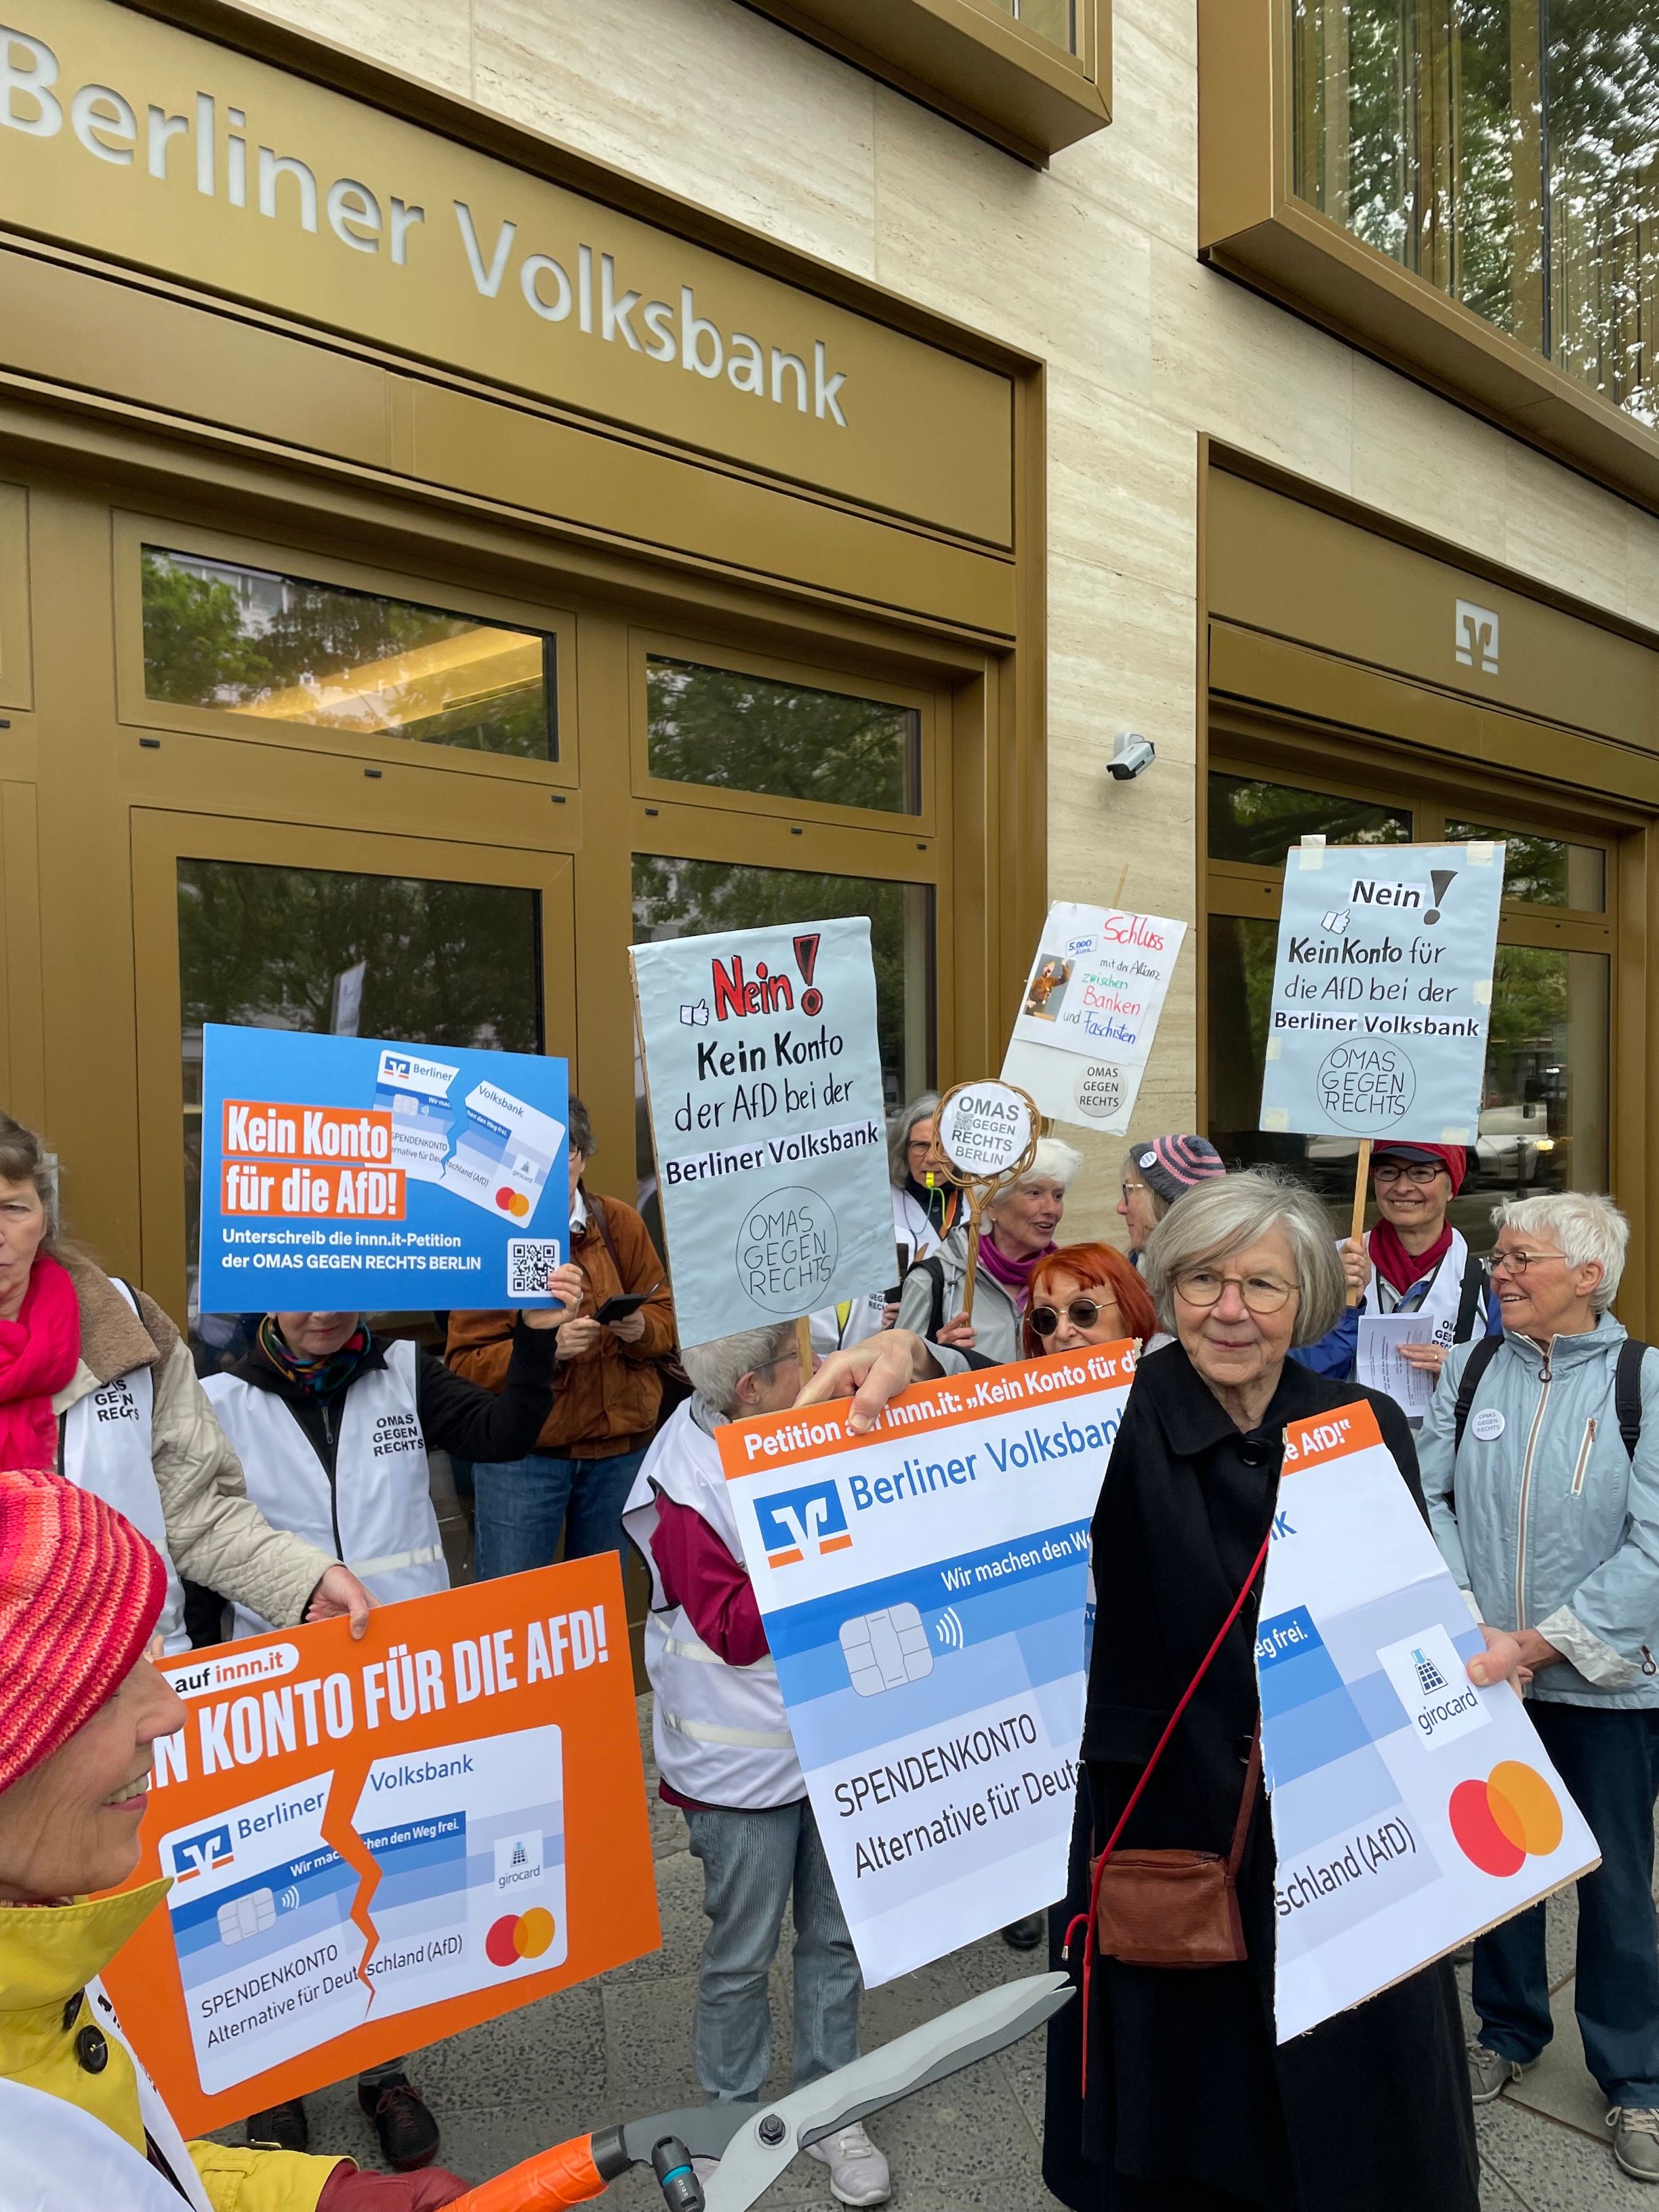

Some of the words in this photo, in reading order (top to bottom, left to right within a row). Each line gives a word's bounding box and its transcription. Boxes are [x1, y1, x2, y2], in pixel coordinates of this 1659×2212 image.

[0, 24, 425, 265] Berliner
[453, 200, 848, 428] Volksbank
[1069, 939, 1092, 951] 5.000
[1103, 916, 1164, 951] Schluss
[1409, 936, 1447, 964] für
[1082, 972, 1128, 989] zwischen
[1100, 958, 1115, 968] mit
[1116, 961, 1129, 972] der
[1130, 960, 1160, 981] Allianz
[1083, 985, 1141, 1015] Banken
[1285, 975, 1317, 999] die
[1322, 976, 1364, 1000] AfD
[1369, 977, 1408, 1001] bei
[1418, 978, 1458, 1002] der
[1063, 1011, 1080, 1024] und
[1084, 1010, 1136, 1044] Faschisten
[1274, 1012, 1357, 1031] Berliner
[1364, 1015, 1480, 1036] Volksbank
[697, 1040, 766, 1081] Kein
[774, 1025, 843, 1067] Konto
[1330, 1048, 1395, 1071] OMAS
[413, 1064, 453, 1082] Berliner
[1087, 1067, 1118, 1078] OMAS
[1322, 1071, 1404, 1093] GEGEN
[1080, 1095, 1119, 1107] RECHTS
[1083, 1082, 1118, 1092] GEGEN
[479, 1085, 525, 1118] Volksbank
[675, 1092, 726, 1131] der
[733, 1082, 777, 1122] AfD
[785, 1078, 816, 1113] bei
[823, 1073, 854, 1106] der
[959, 1096, 1019, 1121] OMAS
[1324, 1091, 1406, 1115] RECHTS
[227, 1105, 295, 1153] Kein
[304, 1111, 388, 1160] Konto
[477, 1115, 487, 1125] den
[487, 1120, 498, 1131] Weg
[972, 1119, 1016, 1135] GEGEN
[391, 1132, 448, 1151] SPENDENKONTO
[666, 1147, 763, 1185] Berliner
[769, 1121, 879, 1163] Volksbank
[951, 1129, 1012, 1151] RECHTS
[418, 1151, 428, 1160] für
[955, 1145, 1004, 1165] BERLIN
[226, 1165, 273, 1212] für
[281, 1168, 329, 1213] die
[337, 1171, 397, 1215] AfD!
[472, 1172, 489, 1187] (AfD)
[750, 1206, 813, 1241] OMAS
[223, 1229, 325, 1246] Unterschreib
[329, 1231, 352, 1246] die
[356, 1232, 461, 1248] innn.it-Petition
[744, 1230, 826, 1269] GEGEN
[222, 1254, 249, 1268] der
[253, 1254, 304, 1269] OMAS
[307, 1255, 363, 1269] GEGEN
[365, 1256, 426, 1269] RECHTS
[429, 1257, 481, 1270] BERLIN
[749, 1255, 832, 1295] RECHTS
[376, 1414, 414, 1429] OMAS
[743, 1420, 841, 1460] Petition
[884, 1391, 963, 1429] innn.it:
[966, 1376, 1024, 1410] „Kein
[1026, 1364, 1086, 1397] Konto
[1088, 1356, 1117, 1380] für
[373, 1426, 418, 1443] GEGEN
[373, 1438, 424, 1457] RECHTS
[848, 1453, 977, 1511] Berliner
[985, 1408, 1124, 1473] Volksban
[941, 1565, 972, 1591] Wir
[976, 1549, 1042, 1585] machen
[1042, 1534, 1070, 1563] den
[1272, 1620, 1308, 1649] frei.
[175, 1669, 211, 1694] auf
[216, 1651, 284, 1682] innn.it
[199, 1672, 354, 1776] KONTO
[362, 1641, 443, 1730] FÜR
[452, 1630, 518, 1704] DIE
[527, 1605, 609, 1684] AFD!
[1417, 1686, 1479, 1736] girocard
[370, 1755, 474, 1792] Volksbank
[834, 1714, 1037, 1817] SPENDENKONTO
[237, 1791, 325, 1839] Berliner
[390, 1830, 411, 1845] den
[412, 1825, 436, 1840] Weg
[438, 1818, 459, 1834] frei.
[855, 1801, 987, 1879] Alternative
[986, 1784, 1020, 1820] für
[290, 1862, 312, 1877] Wir
[499, 1865, 541, 1889] girocard
[1275, 1845, 1362, 1917] schland
[1357, 1817, 1416, 1875] (AfD)
[367, 1946, 424, 1976] schland
[428, 1934, 463, 1963] (AfD)
[201, 1944, 338, 2018] SPENDENKONTO
[207, 1996, 295, 2048] Alternative
[298, 1984, 320, 2008] für
